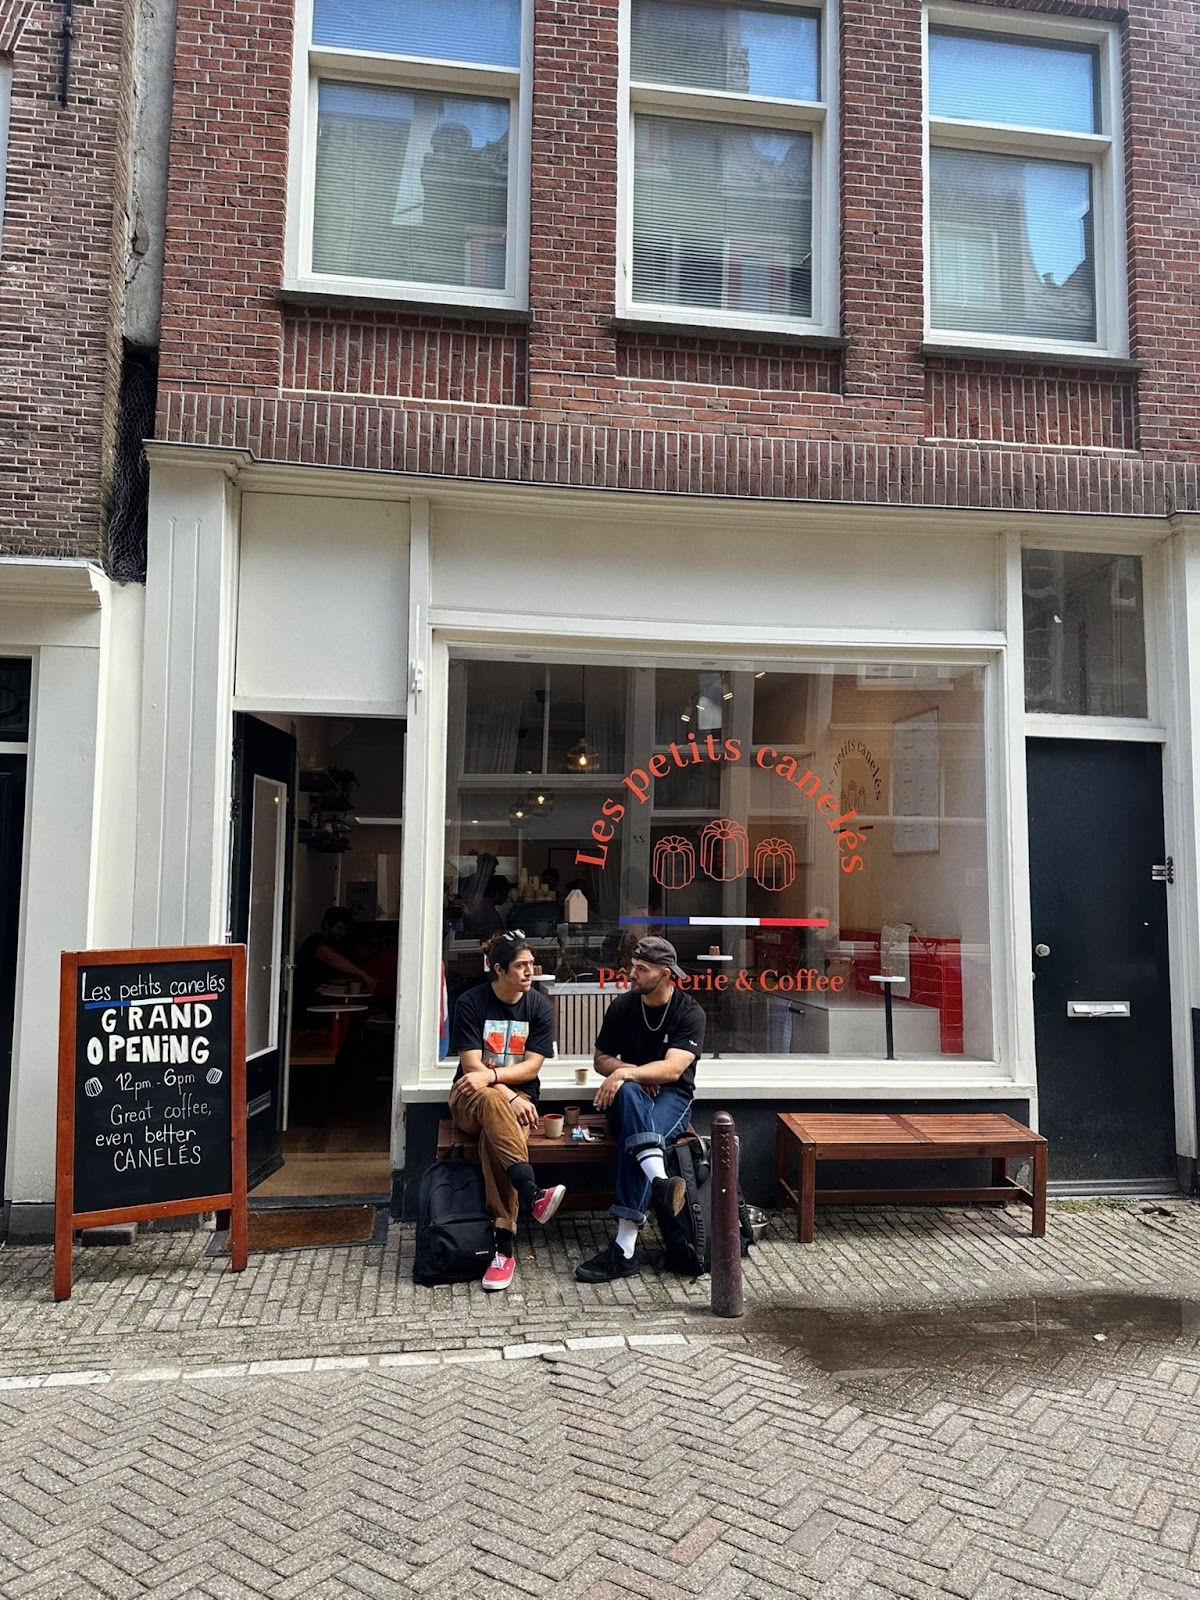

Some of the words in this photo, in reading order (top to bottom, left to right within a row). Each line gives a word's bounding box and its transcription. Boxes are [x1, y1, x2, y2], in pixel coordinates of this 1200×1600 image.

[575, 798, 626, 870] Les
[621, 732, 742, 805] petits
[756, 746, 868, 874] canelés
[81, 971, 112, 1002] Les
[119, 973, 162, 1016] petits
[169, 971, 226, 993] canelés
[735, 968, 754, 992] &
[759, 968, 845, 993] Coffee
[101, 1002, 213, 1033] GRAND
[163, 1068, 196, 1096] 6pm
[110, 1100, 154, 1126] Great
[164, 1092, 212, 1120] coffee,
[95, 1132, 134, 1147] even
[145, 1122, 197, 1145] better
[113, 1144, 201, 1173] CANELÉS
